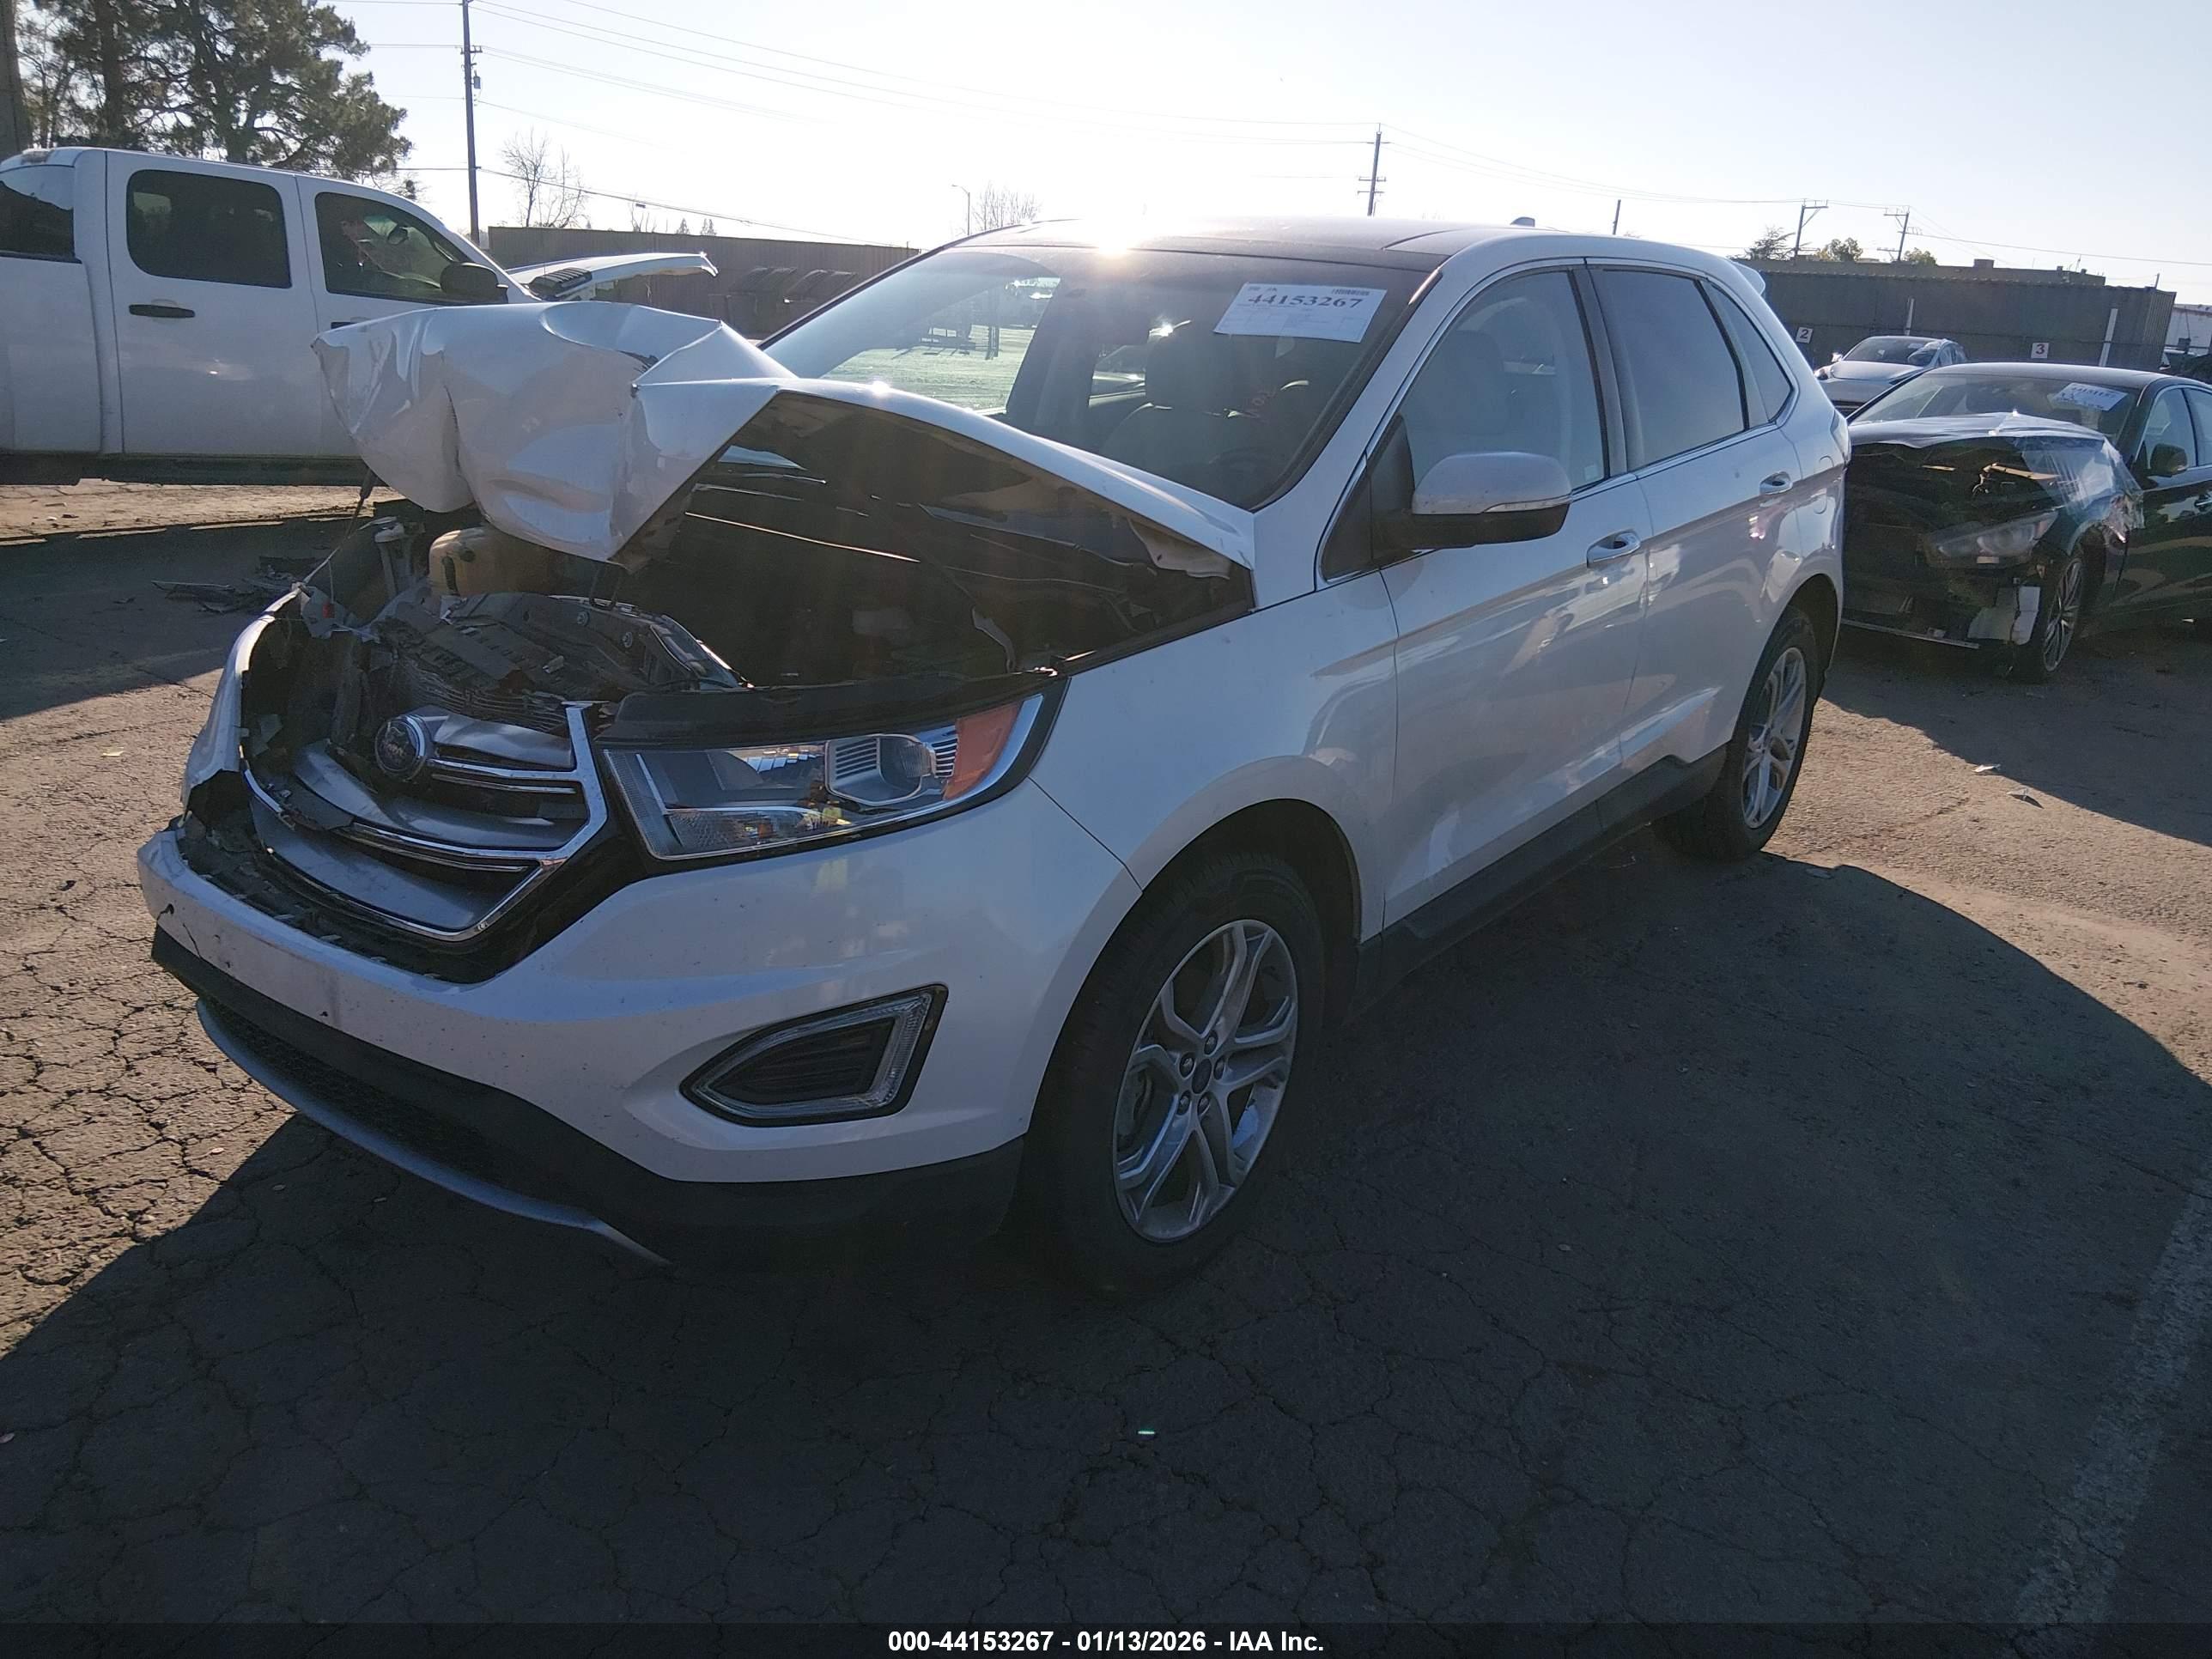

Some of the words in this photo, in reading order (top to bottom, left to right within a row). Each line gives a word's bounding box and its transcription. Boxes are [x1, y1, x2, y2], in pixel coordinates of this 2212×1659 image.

[1248, 294, 1364, 308] 44153267
[1799, 329, 1809, 339] 2
[2035, 343, 2045, 355] 3
